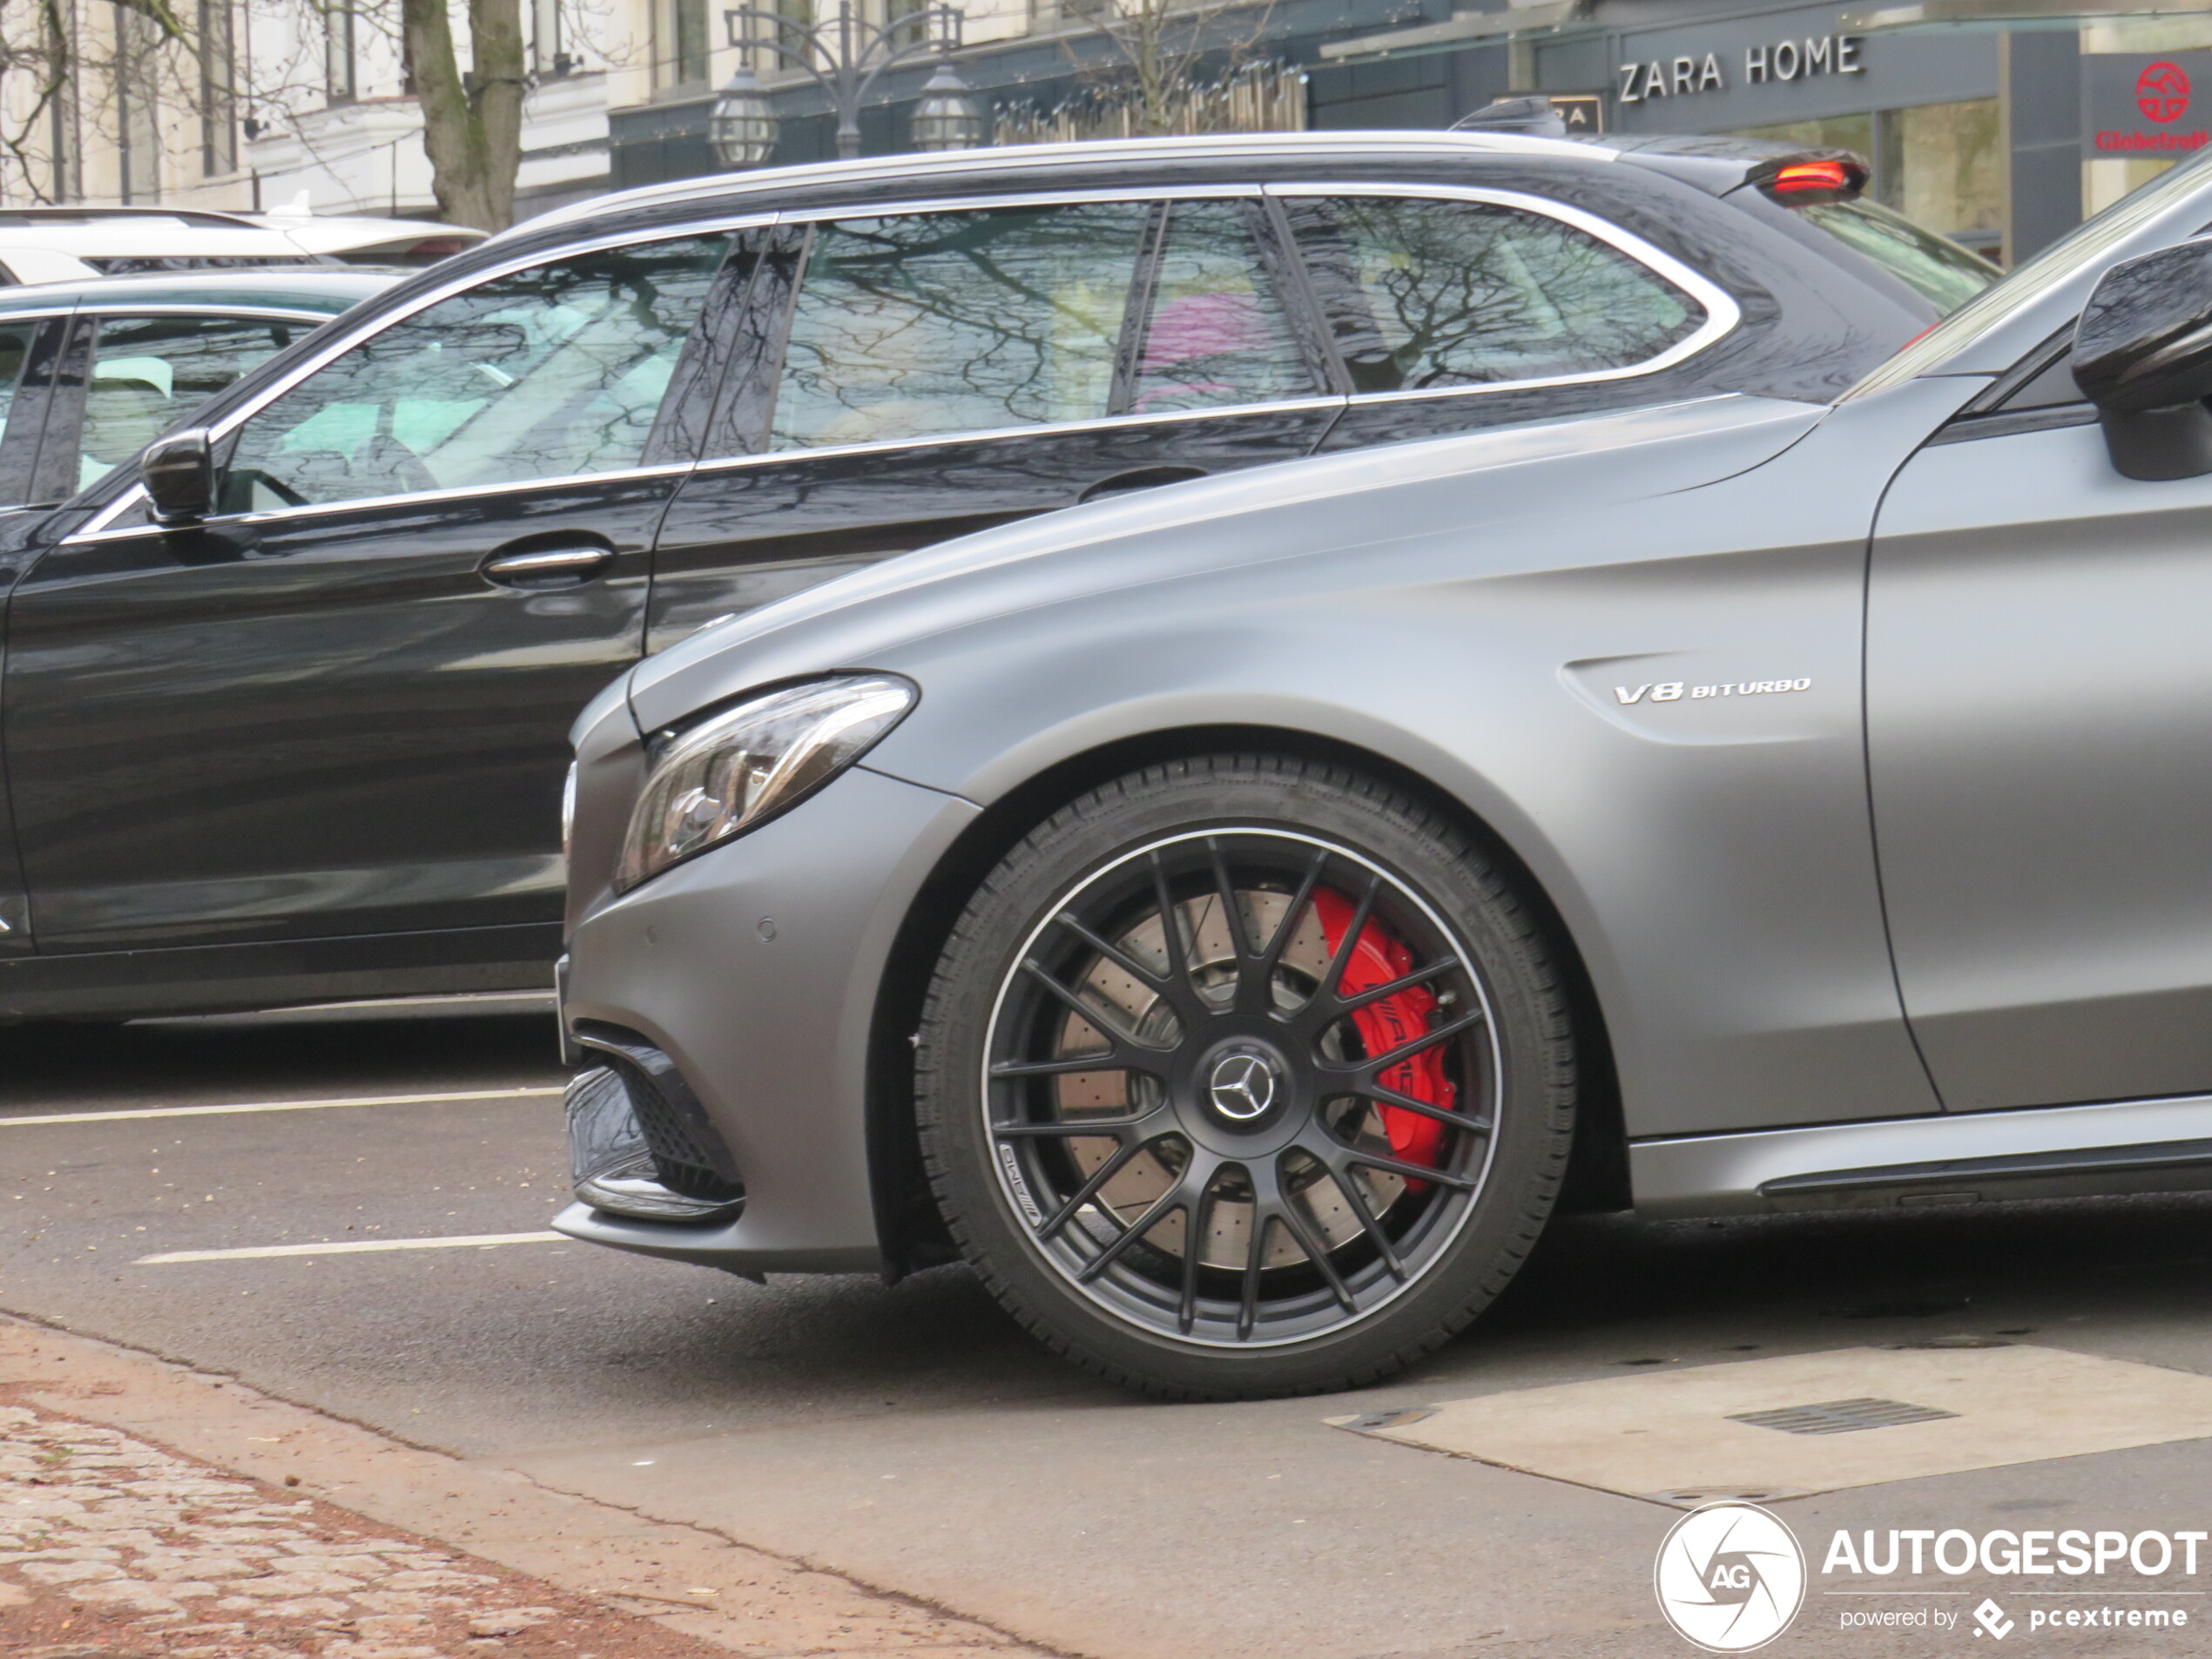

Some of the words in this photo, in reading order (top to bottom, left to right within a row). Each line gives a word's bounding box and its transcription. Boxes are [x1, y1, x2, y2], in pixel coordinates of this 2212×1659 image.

[1620, 52, 1723, 103] ZARA
[1745, 35, 1859, 84] HOME
[1614, 681, 1684, 705] V8
[1691, 678, 1811, 699] BITURBO
